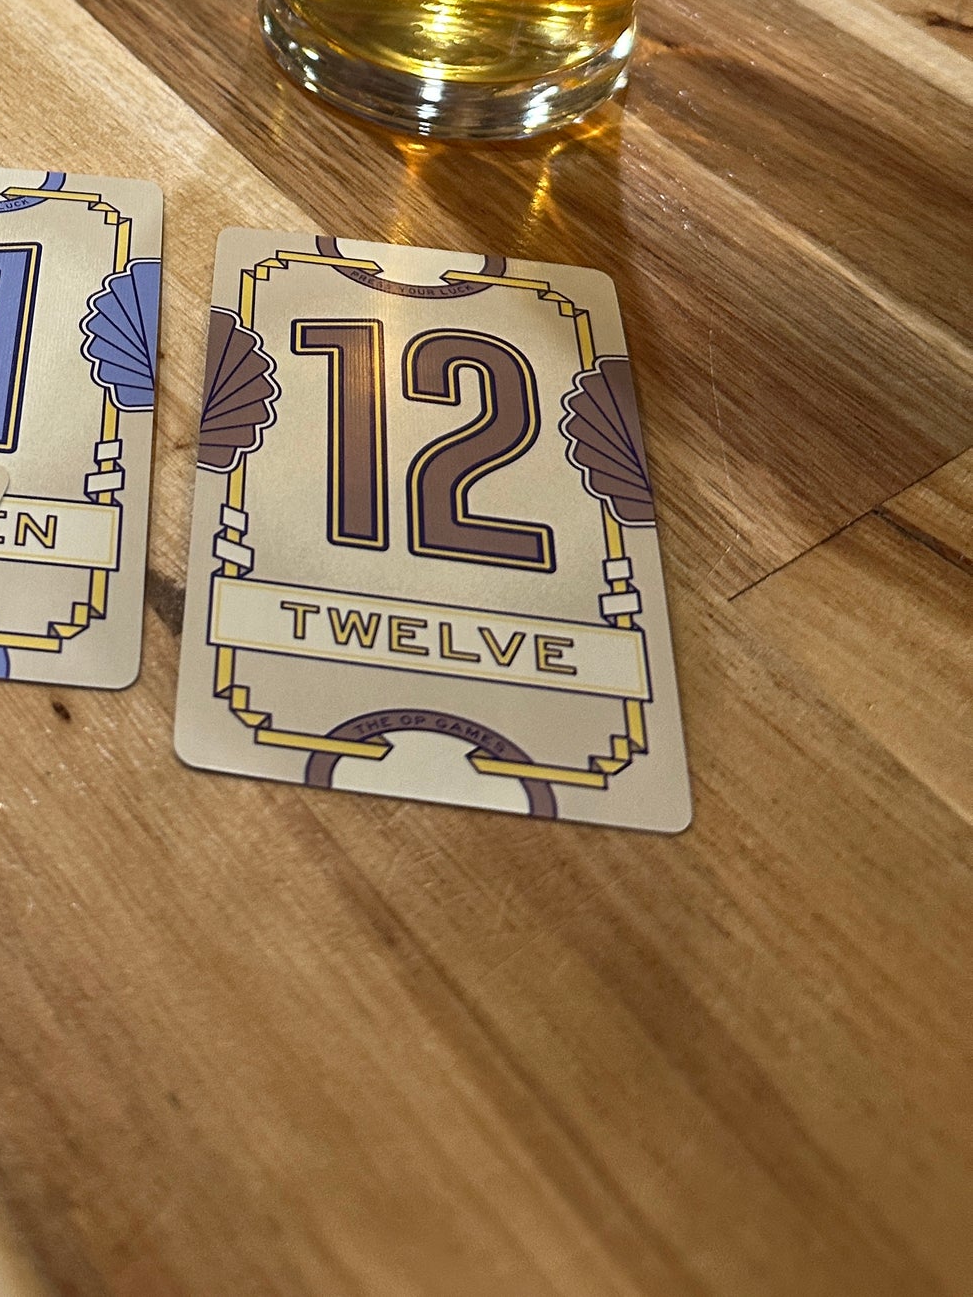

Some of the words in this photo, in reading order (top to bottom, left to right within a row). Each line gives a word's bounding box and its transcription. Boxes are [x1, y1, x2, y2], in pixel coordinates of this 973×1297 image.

[349, 270, 391, 290] PRESS
[399, 286, 435, 296] YOUR
[439, 284, 474, 296] LUCK
[291, 318, 556, 574] 12
[280, 600, 578, 676] TWELVE
[353, 715, 394, 734] THE
[435, 717, 505, 754] GAMES
